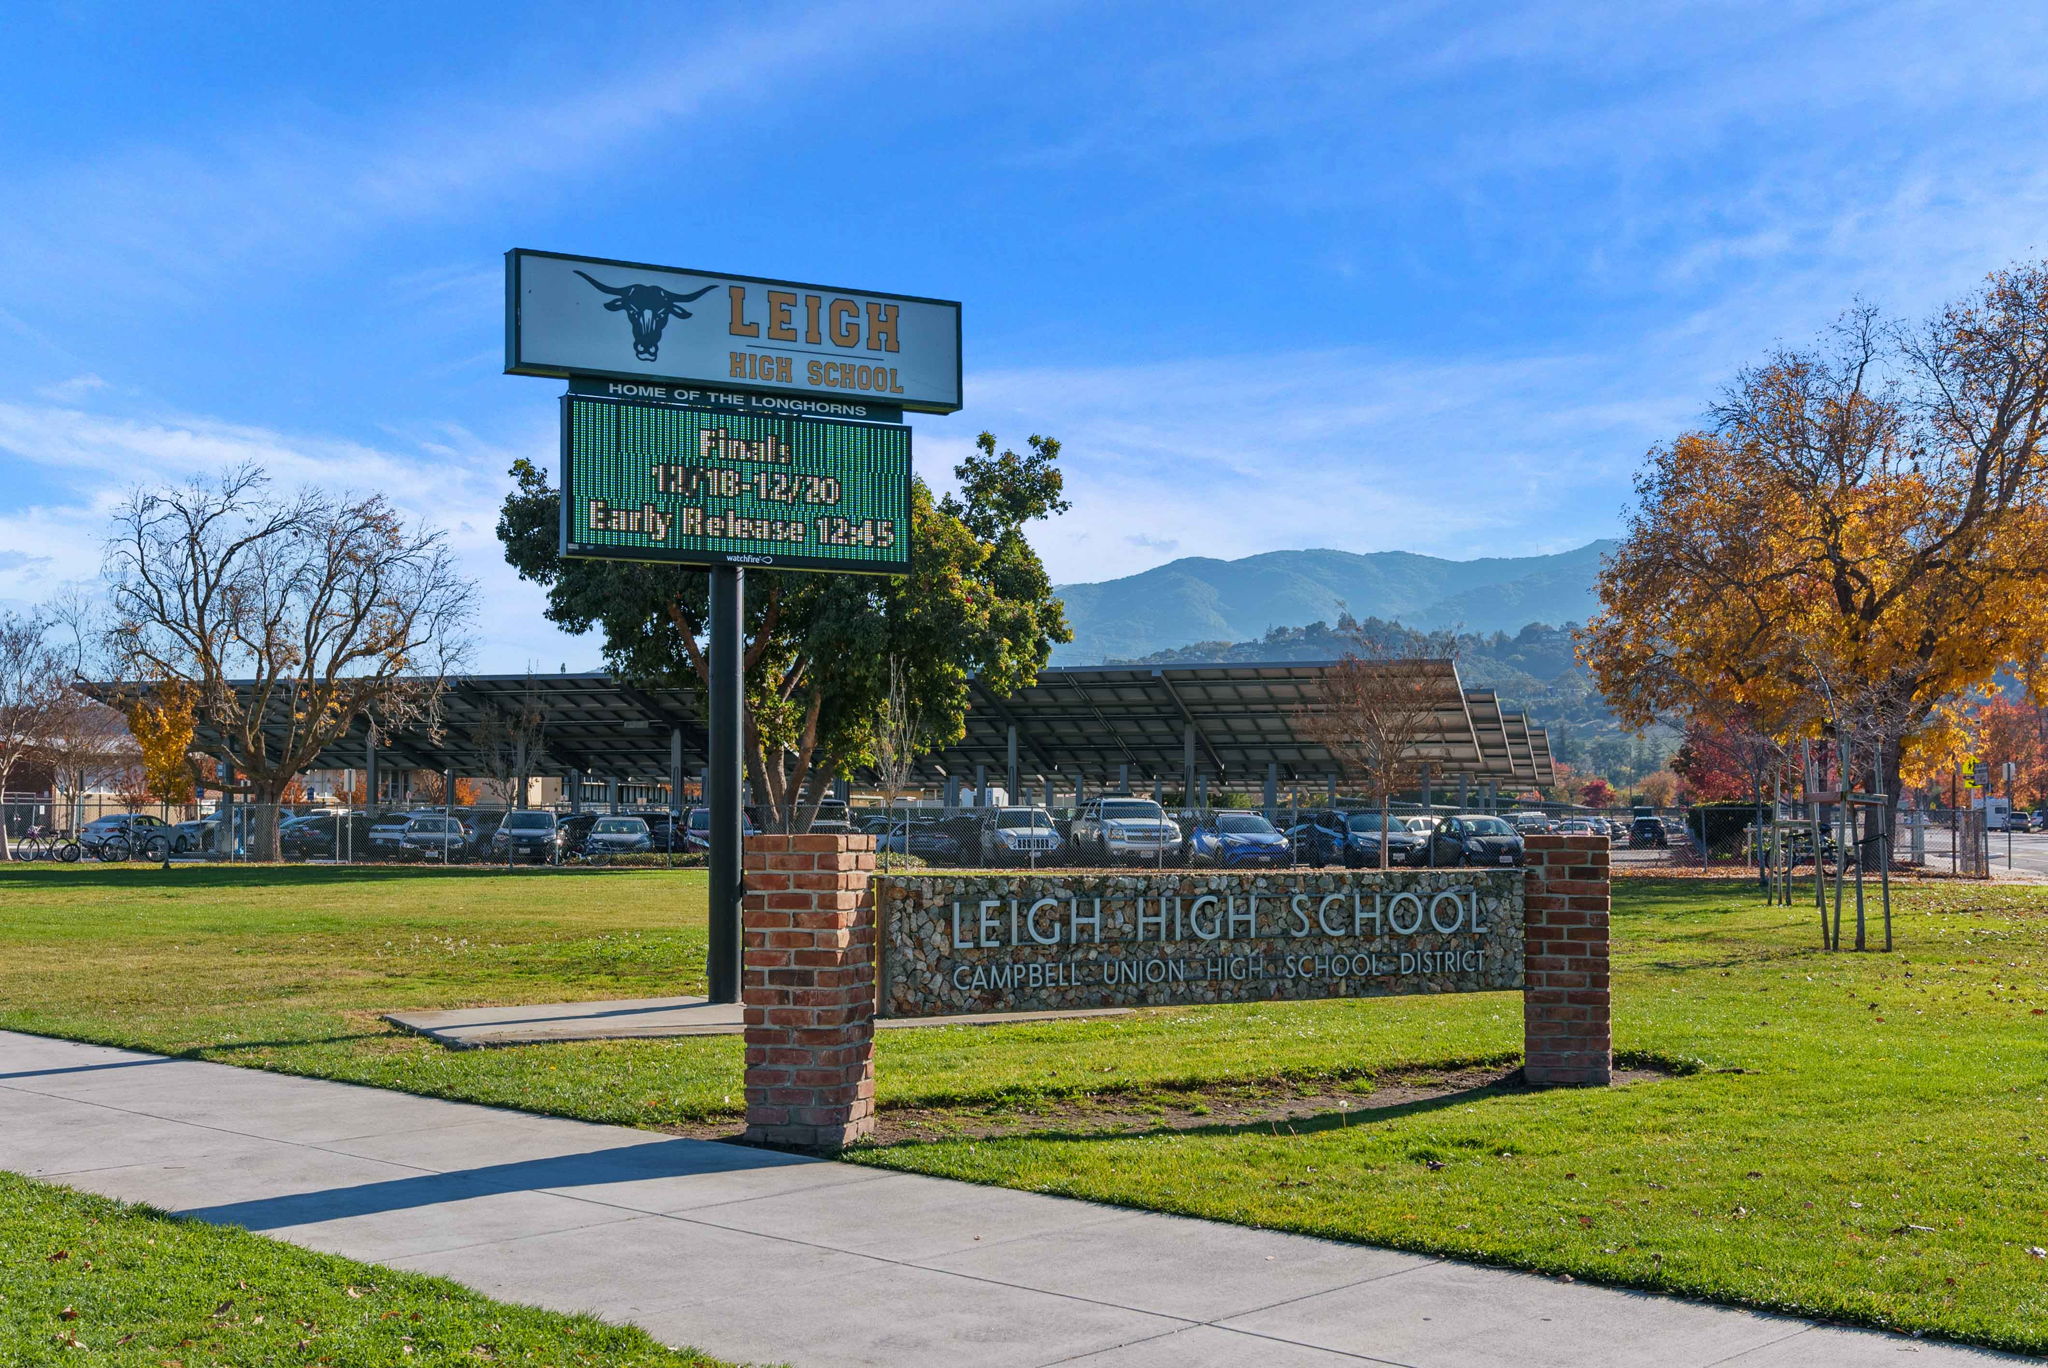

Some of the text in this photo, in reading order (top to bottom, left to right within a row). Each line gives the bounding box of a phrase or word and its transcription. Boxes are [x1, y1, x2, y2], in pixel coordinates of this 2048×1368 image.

[729, 285, 900, 353] LEIGH
[729, 352, 904, 394] HIGH SCHOOL
[608, 383, 867, 416] HOME OF THE LONGHORNS
[700, 428, 791, 464] Finals
[590, 501, 894, 547] Early Release 12:45
[726, 553, 760, 565] watchfire
[953, 891, 1487, 949] LEIGH HIGH SCHOOL
[953, 950, 1485, 991] CAMPBELL UNION HIGH SCHOOL DISTRICT
